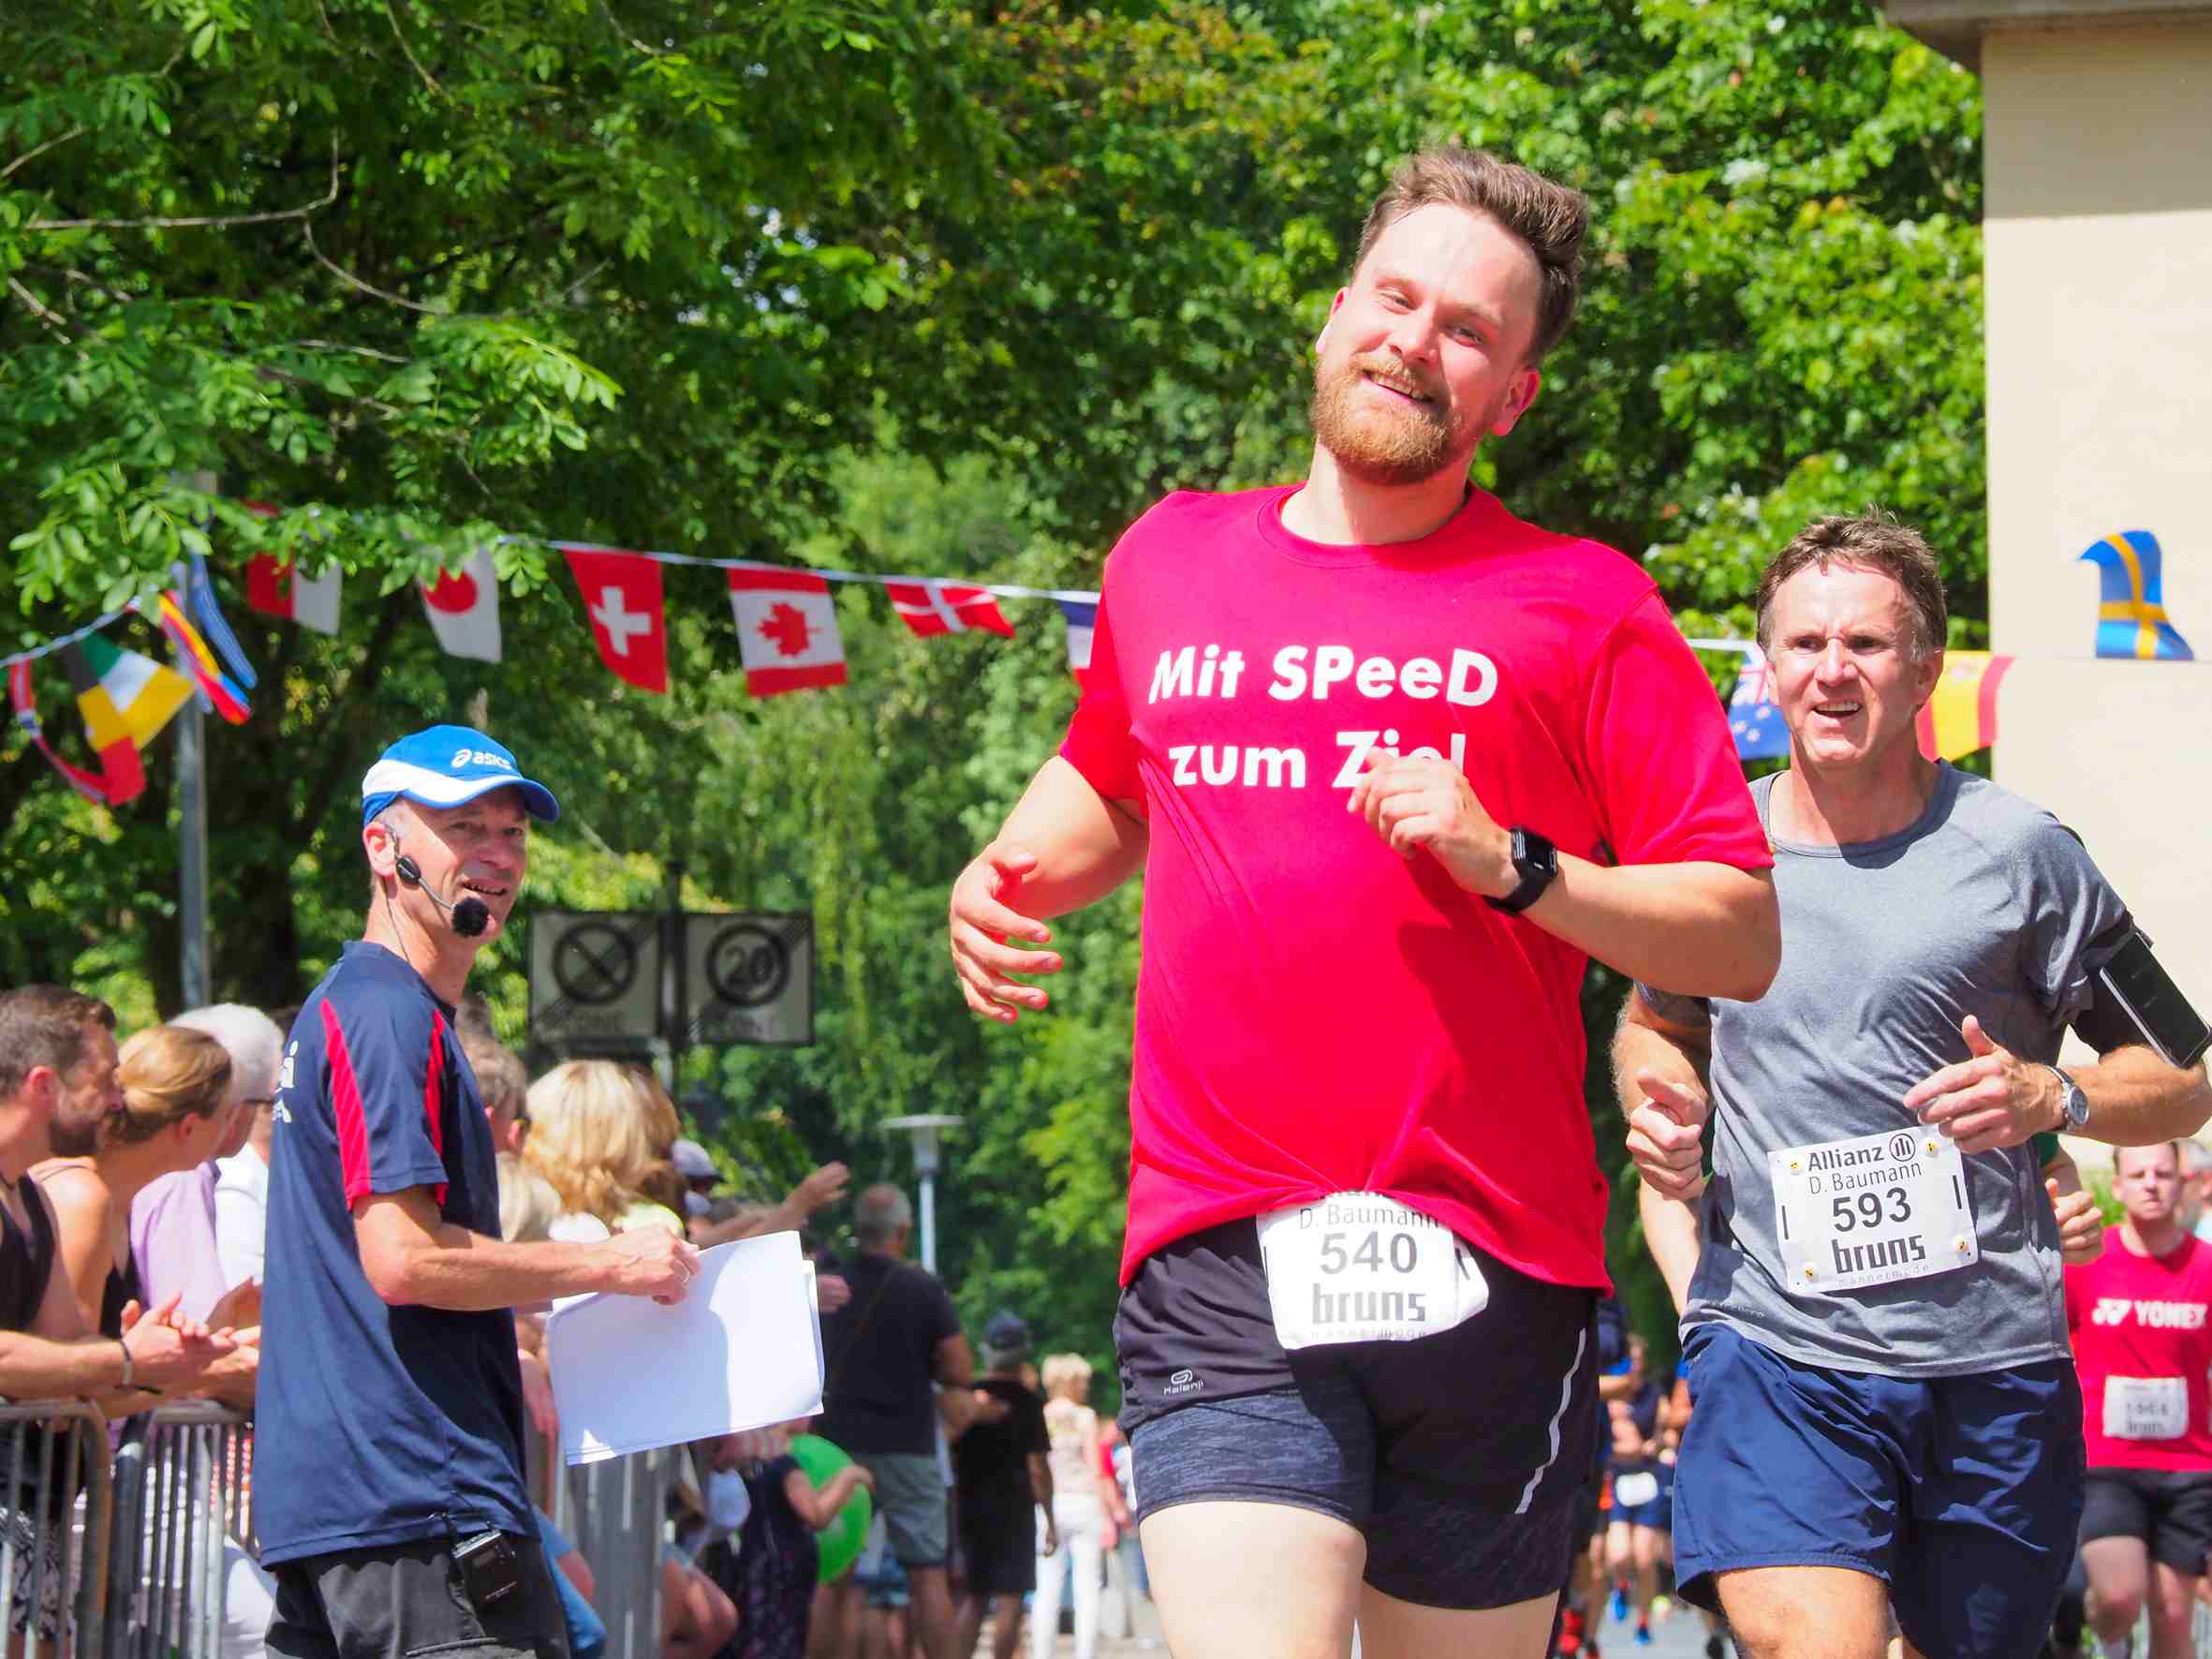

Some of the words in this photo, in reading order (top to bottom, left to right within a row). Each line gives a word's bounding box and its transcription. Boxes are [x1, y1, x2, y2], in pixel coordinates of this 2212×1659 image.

[1149, 644, 1245, 704] Mit
[1268, 645, 1498, 706] SPeeD
[472, 751, 511, 769] asics
[1169, 746, 1306, 788] zum
[1332, 729, 1466, 788] Zil
[724, 946, 774, 985] 20
[1808, 1146, 1884, 1172] Allianz
[1809, 1176, 1828, 1195] D.
[1833, 1163, 1922, 1192] Baumann
[1327, 1204, 1439, 1229] Baumann
[1833, 1187, 1911, 1232] 593
[1320, 1231, 1418, 1274] 540
[1831, 1235, 1926, 1274] bruns
[1313, 1283, 1426, 1325] bruns
[2134, 1300, 2208, 1329] YONEX
